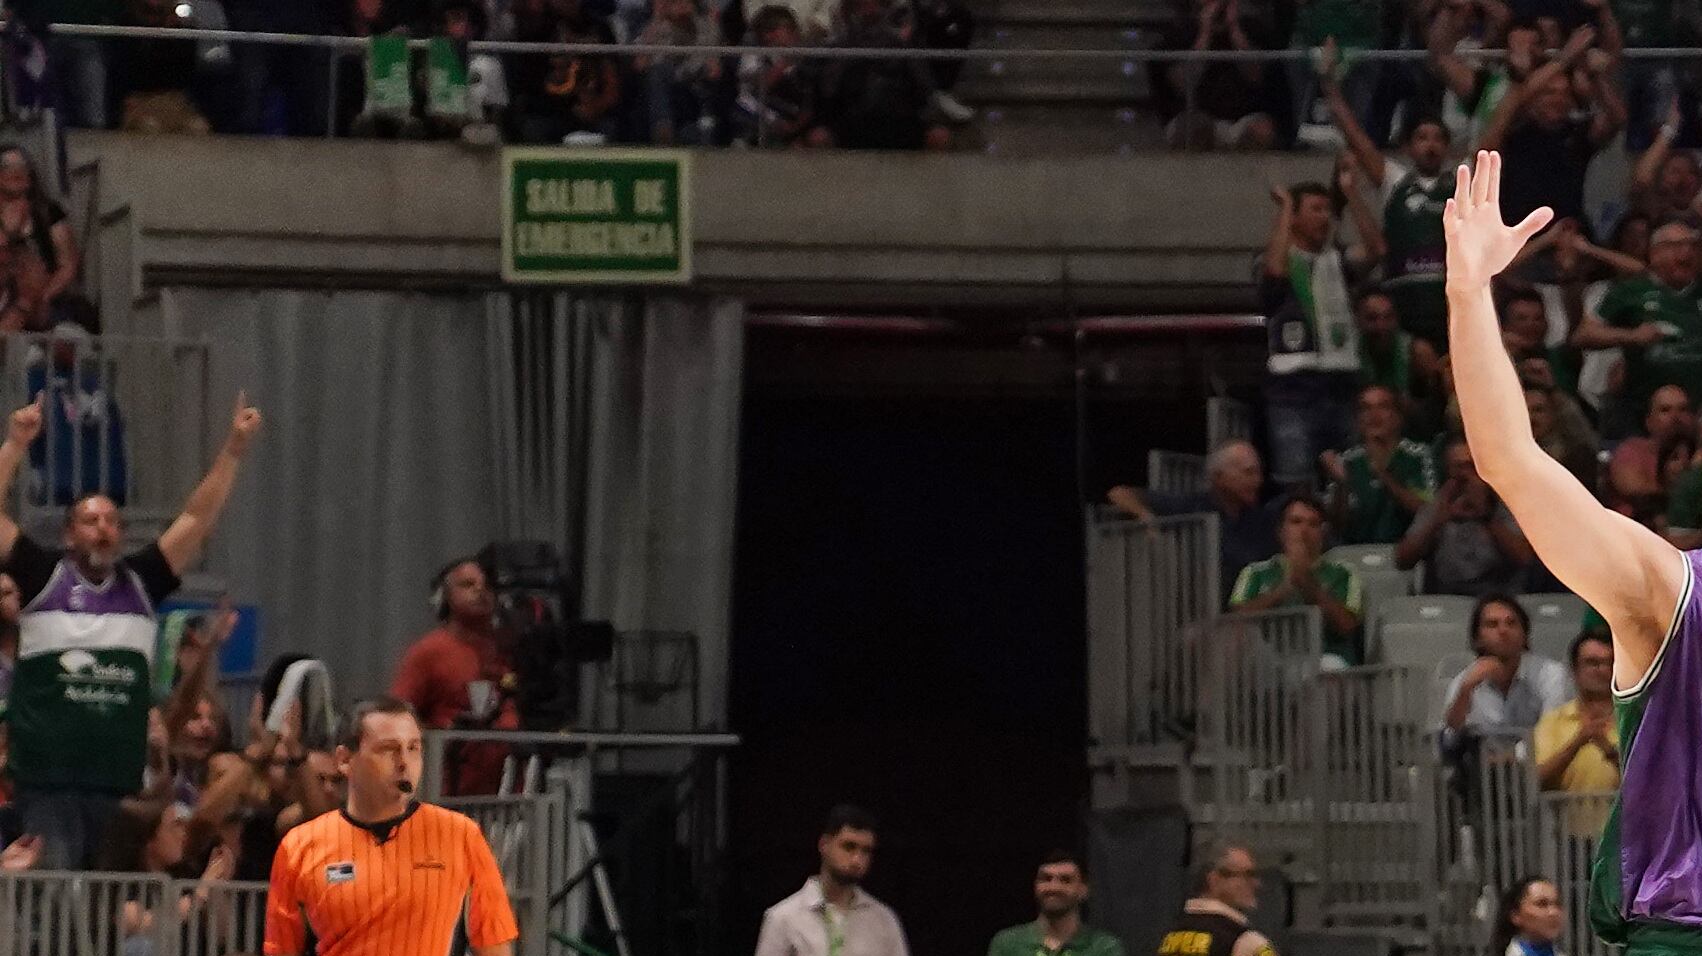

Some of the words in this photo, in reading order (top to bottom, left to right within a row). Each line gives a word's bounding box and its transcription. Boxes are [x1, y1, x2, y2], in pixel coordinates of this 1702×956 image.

[526, 178, 616, 214] SALIDA
[633, 178, 666, 214] DE
[515, 222, 674, 256] EMERGENCIA
